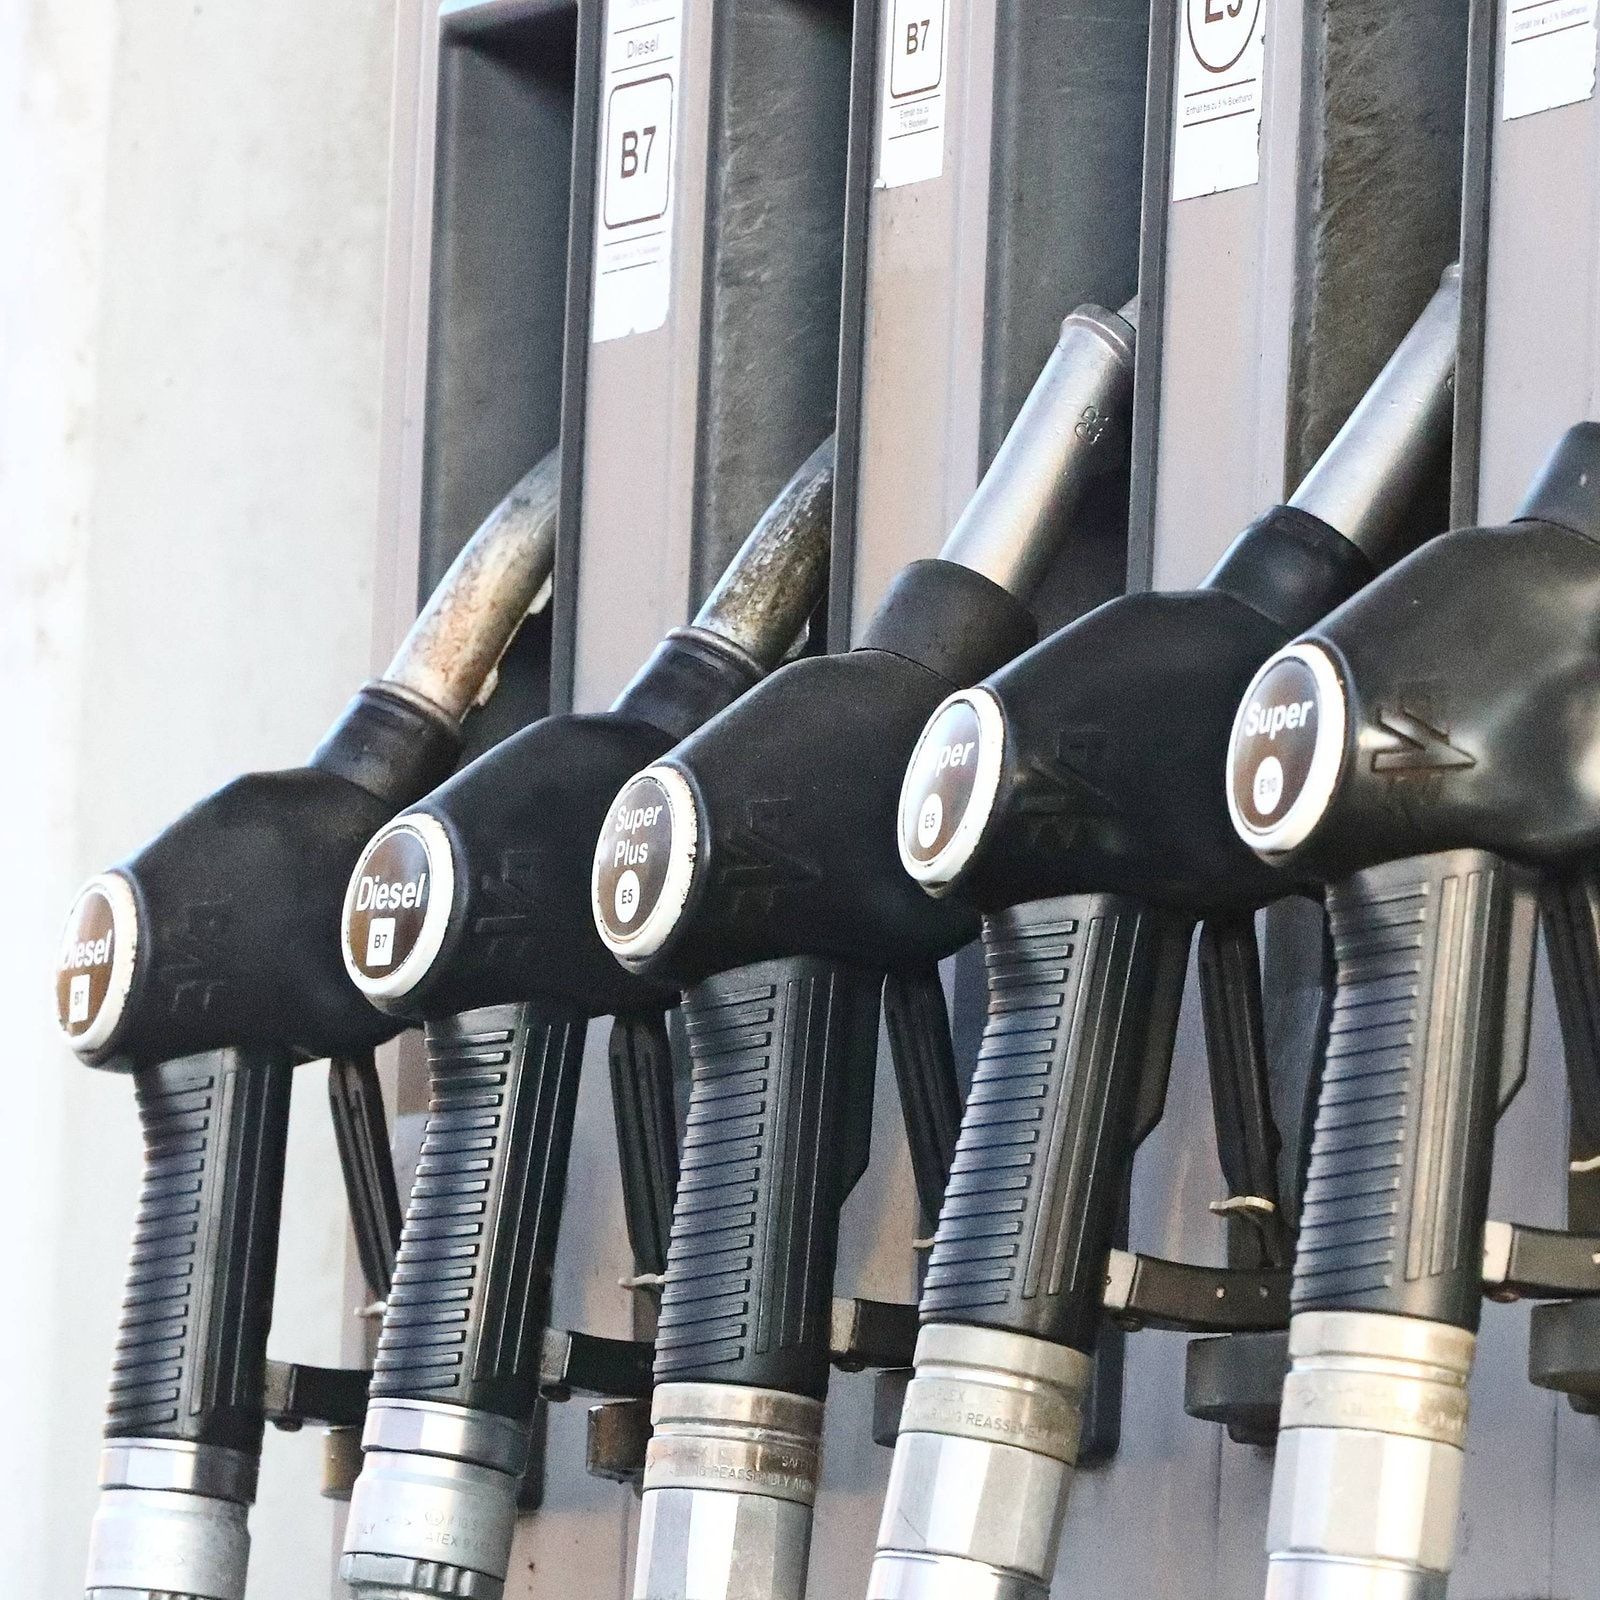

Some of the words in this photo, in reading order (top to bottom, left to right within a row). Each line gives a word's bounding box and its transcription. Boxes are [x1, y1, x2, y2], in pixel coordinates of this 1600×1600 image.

[627, 33, 660, 59] Diesel
[906, 19, 930, 55] B7
[620, 126, 657, 179] B7
[1245, 700, 1314, 741] Super
[614, 805, 663, 834] Super
[924, 813, 935, 829] E5
[613, 840, 648, 868] Plus
[355, 872, 427, 912] Diesel
[621, 889, 633, 905] E5
[374, 933, 388, 949] B7
